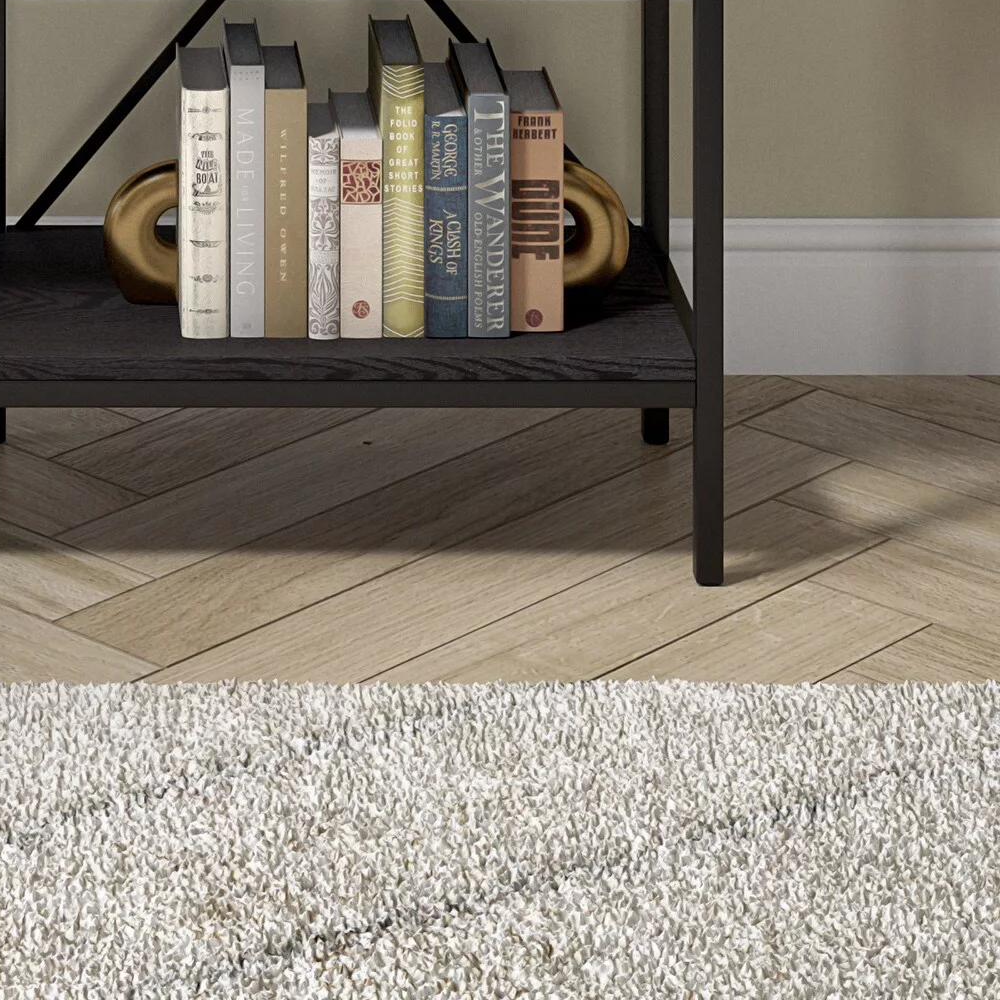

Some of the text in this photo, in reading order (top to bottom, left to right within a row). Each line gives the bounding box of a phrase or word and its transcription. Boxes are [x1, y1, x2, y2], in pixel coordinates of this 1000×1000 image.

[395, 106, 413, 115] THE
[517, 115, 552, 127] FRANK
[389, 119, 418, 128] FOLIO
[512, 128, 558, 140] HERBERT
[236, 108, 255, 180] MADE
[388, 132, 416, 141] BOOK
[200, 150, 215, 159] THE
[396, 145, 408, 154] OF
[430, 140, 442, 180] MARTIN
[441, 123, 458, 178] GEORGE
[473, 137, 483, 176] OTHER
[388, 158, 419, 167] GREAT
[195, 172, 219, 185] BOAT
[388, 171, 419, 180] SHORT
[383, 184, 424, 193] STORIES
[473, 100, 506, 332] THE WANDERER
[473, 212, 483, 235] OLD
[511, 179, 560, 261] DUNE
[427, 218, 444, 265] KINGS
[446, 220, 462, 259] CLASH
[235, 207, 256, 296] LIVING
[473, 237, 483, 287] ENGLISH
[473, 290, 483, 328] POEMS
